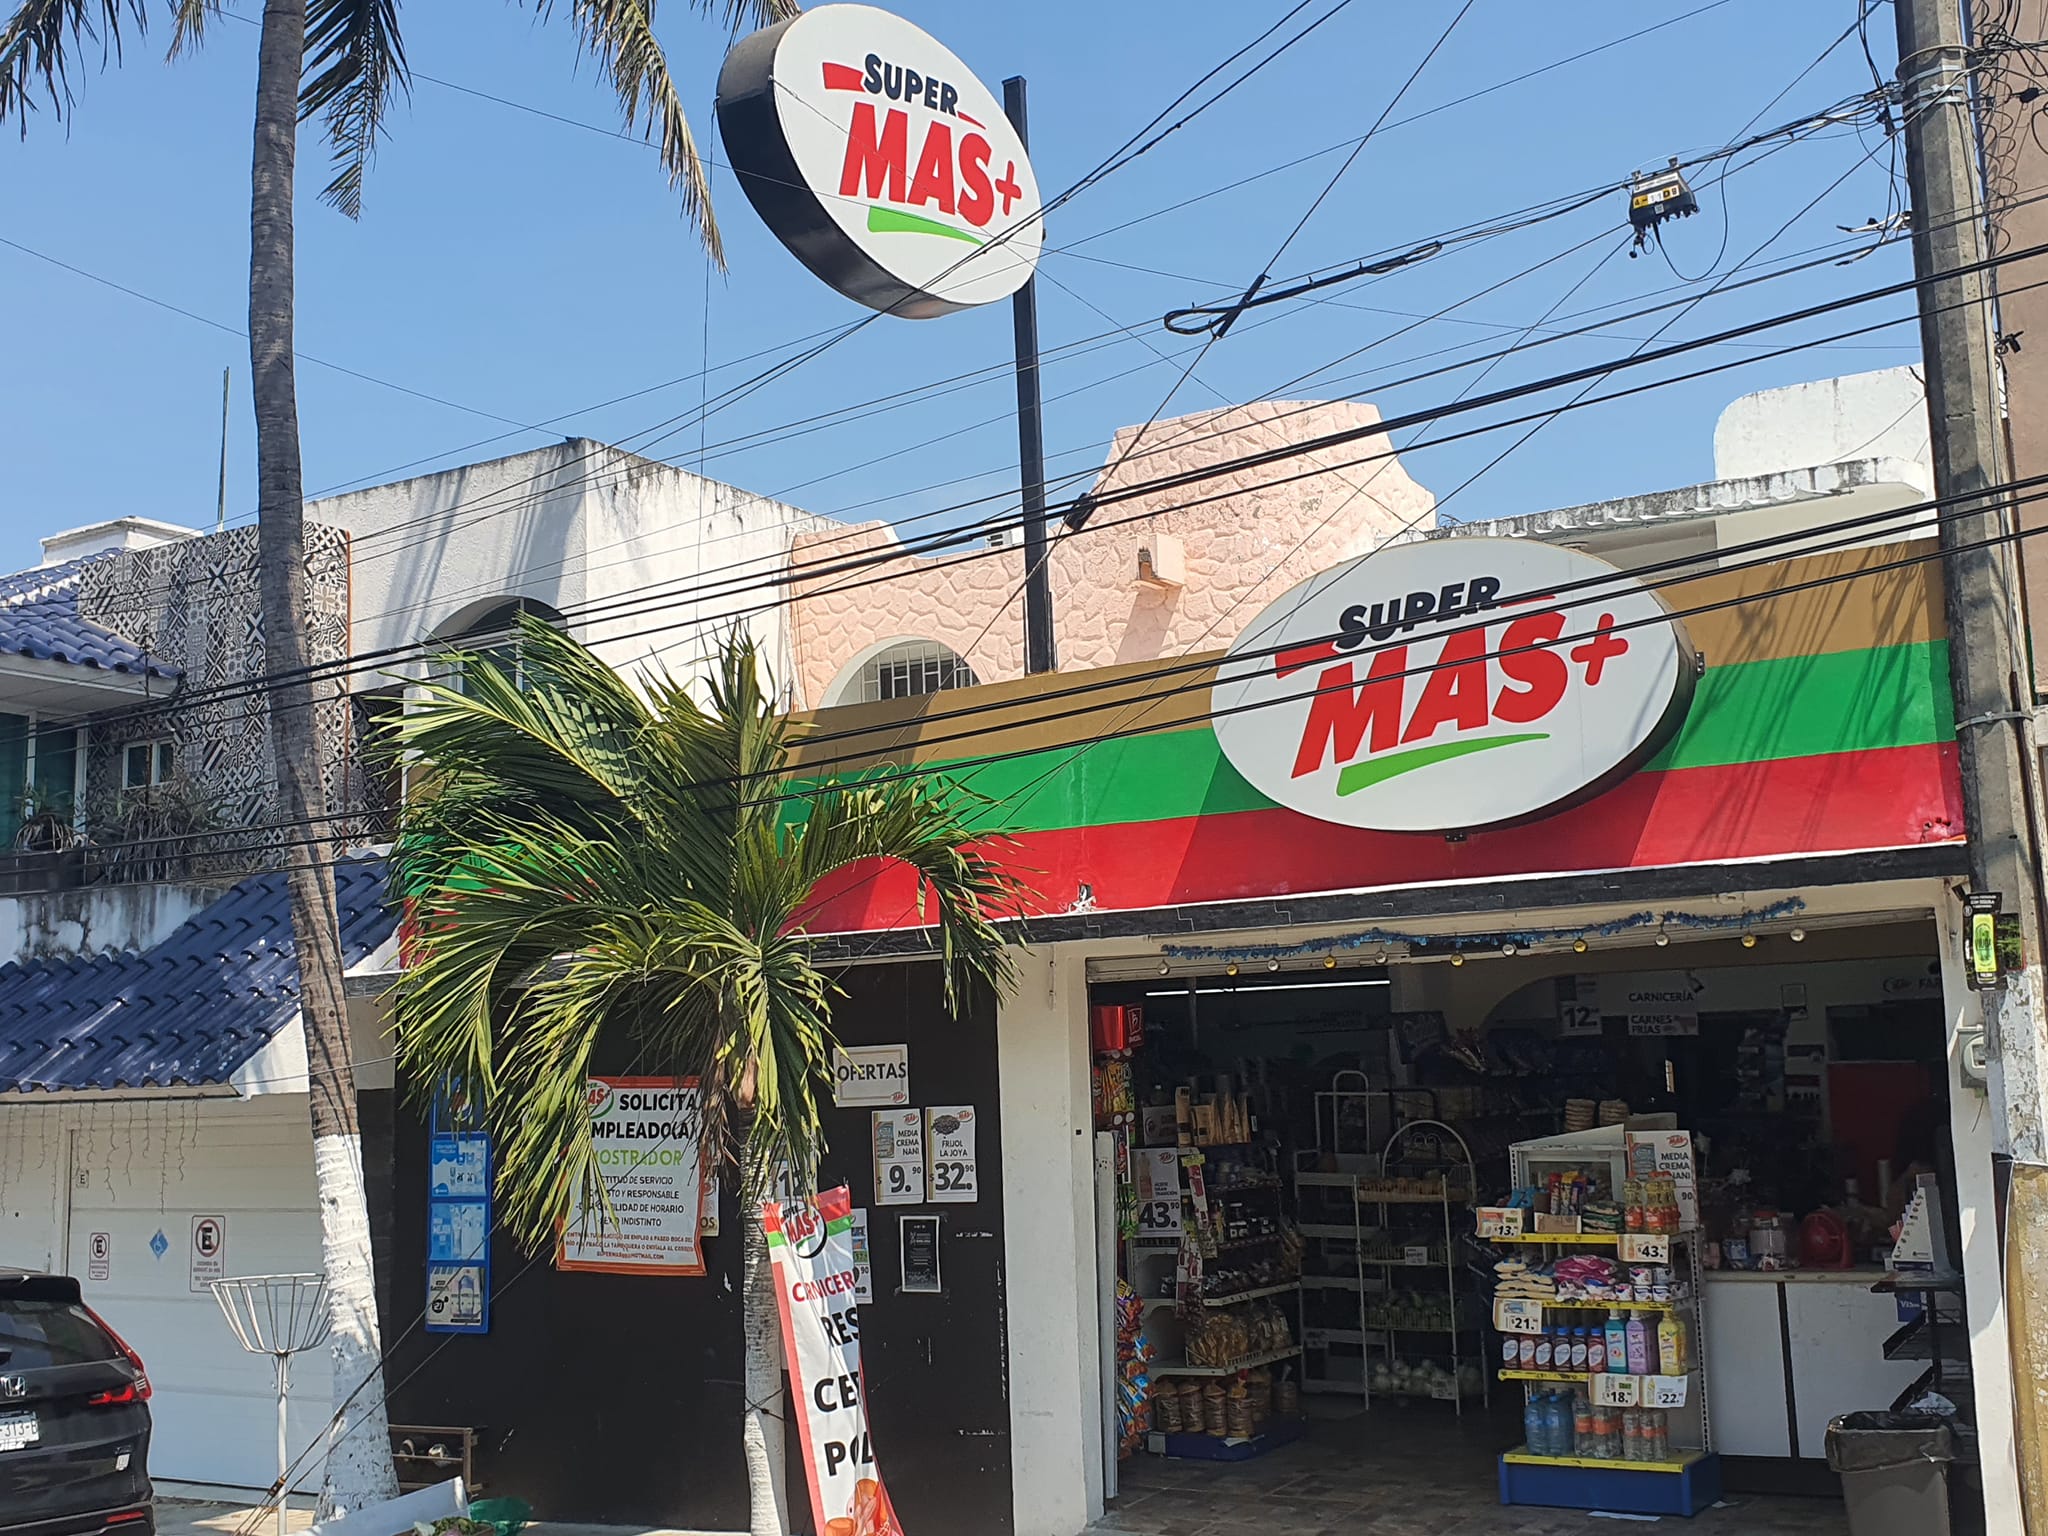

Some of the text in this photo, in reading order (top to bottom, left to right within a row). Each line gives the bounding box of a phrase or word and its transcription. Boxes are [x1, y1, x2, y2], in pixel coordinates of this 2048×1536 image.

[864, 53, 958, 117] SUPER
[1335, 577, 1500, 649] SUPER
[1628, 991, 1694, 1002] CARNICERÍA
[1630, 1015, 1672, 1025] CARNES
[837, 1062, 906, 1082] OFERTAS
[619, 1093, 697, 1111] SOLICITA
[591, 1121, 695, 1140] MPLEADO(A)
[897, 1129, 918, 1138] MEDIA
[896, 1139, 920, 1147] CREMA
[942, 1140, 963, 1148] FRIJOL
[902, 1147, 920, 1156] NANI
[1660, 1152, 1689, 1161] MEDIA
[1658, 1162, 1690, 1170] CREMA
[629, 1176, 639, 1185] DE
[639, 1176, 674, 1186] SERVICIO
[621, 1190, 627, 1198] Y
[627, 1189, 680, 1199] RESPONSABLE
[1681, 1192, 1693, 1200] 90
[639, 1204, 650, 1212] DE
[650, 1204, 684, 1214] HORARIO
[621, 1217, 662, 1227] INDISTINTO
